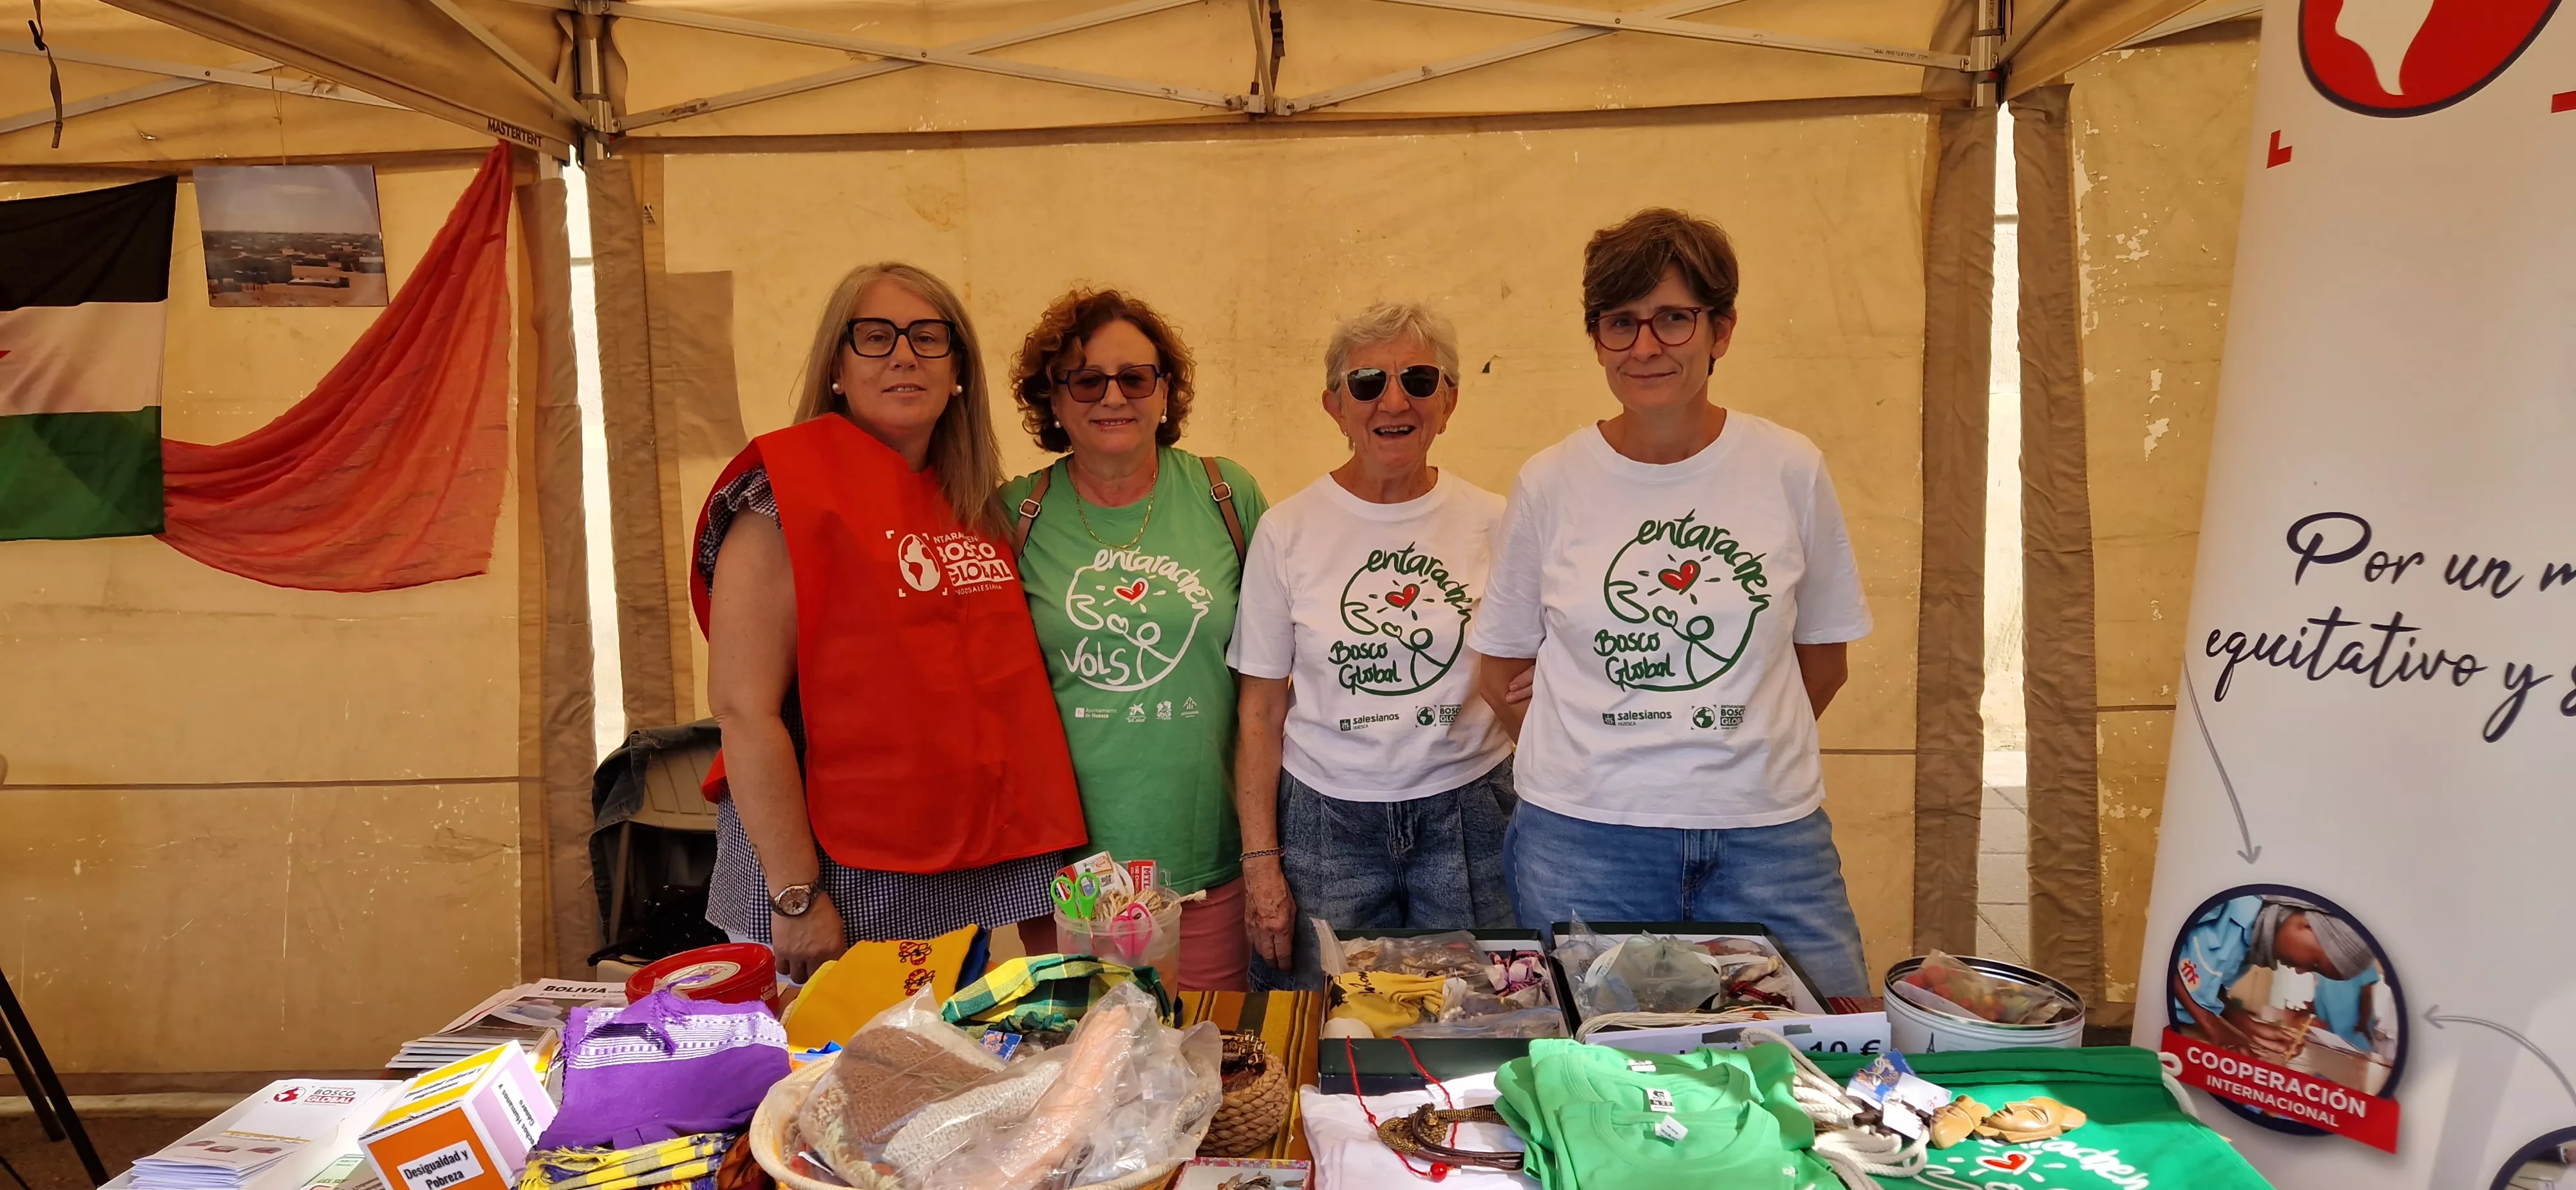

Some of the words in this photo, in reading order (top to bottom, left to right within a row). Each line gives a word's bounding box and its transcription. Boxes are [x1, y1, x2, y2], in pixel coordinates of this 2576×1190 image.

[487, 118, 542, 147] MASTERTENT
[2286, 511, 2425, 586] Por
[2444, 554, 2524, 599] un
[1328, 640, 1388, 665] Bosco
[1593, 628, 1661, 657] Bosco
[1060, 636, 1130, 686] VOLS
[1605, 652, 1676, 692] Global
[2205, 606, 2488, 702] equitativo
[2482, 661, 2555, 743] y
[1338, 660, 1403, 695] Global
[1352, 713, 1400, 725] salesianos
[1617, 709, 1672, 721] salesianos
[1721, 708, 1744, 717] BOSC
[543, 985, 607, 994] BOLIVIA
[1859, 1039, 1882, 1056] €
[2187, 1045, 2367, 1119] COOPERACIÓN
[502, 1090, 523, 1125] Humanos
[518, 1099, 535, 1126] Género
[2206, 1074, 2340, 1128] INTERNACIONAL
[403, 1149, 462, 1180] Desigualdad
[460, 1149, 469, 1160] y
[425, 1169, 465, 1190] Pobreza
